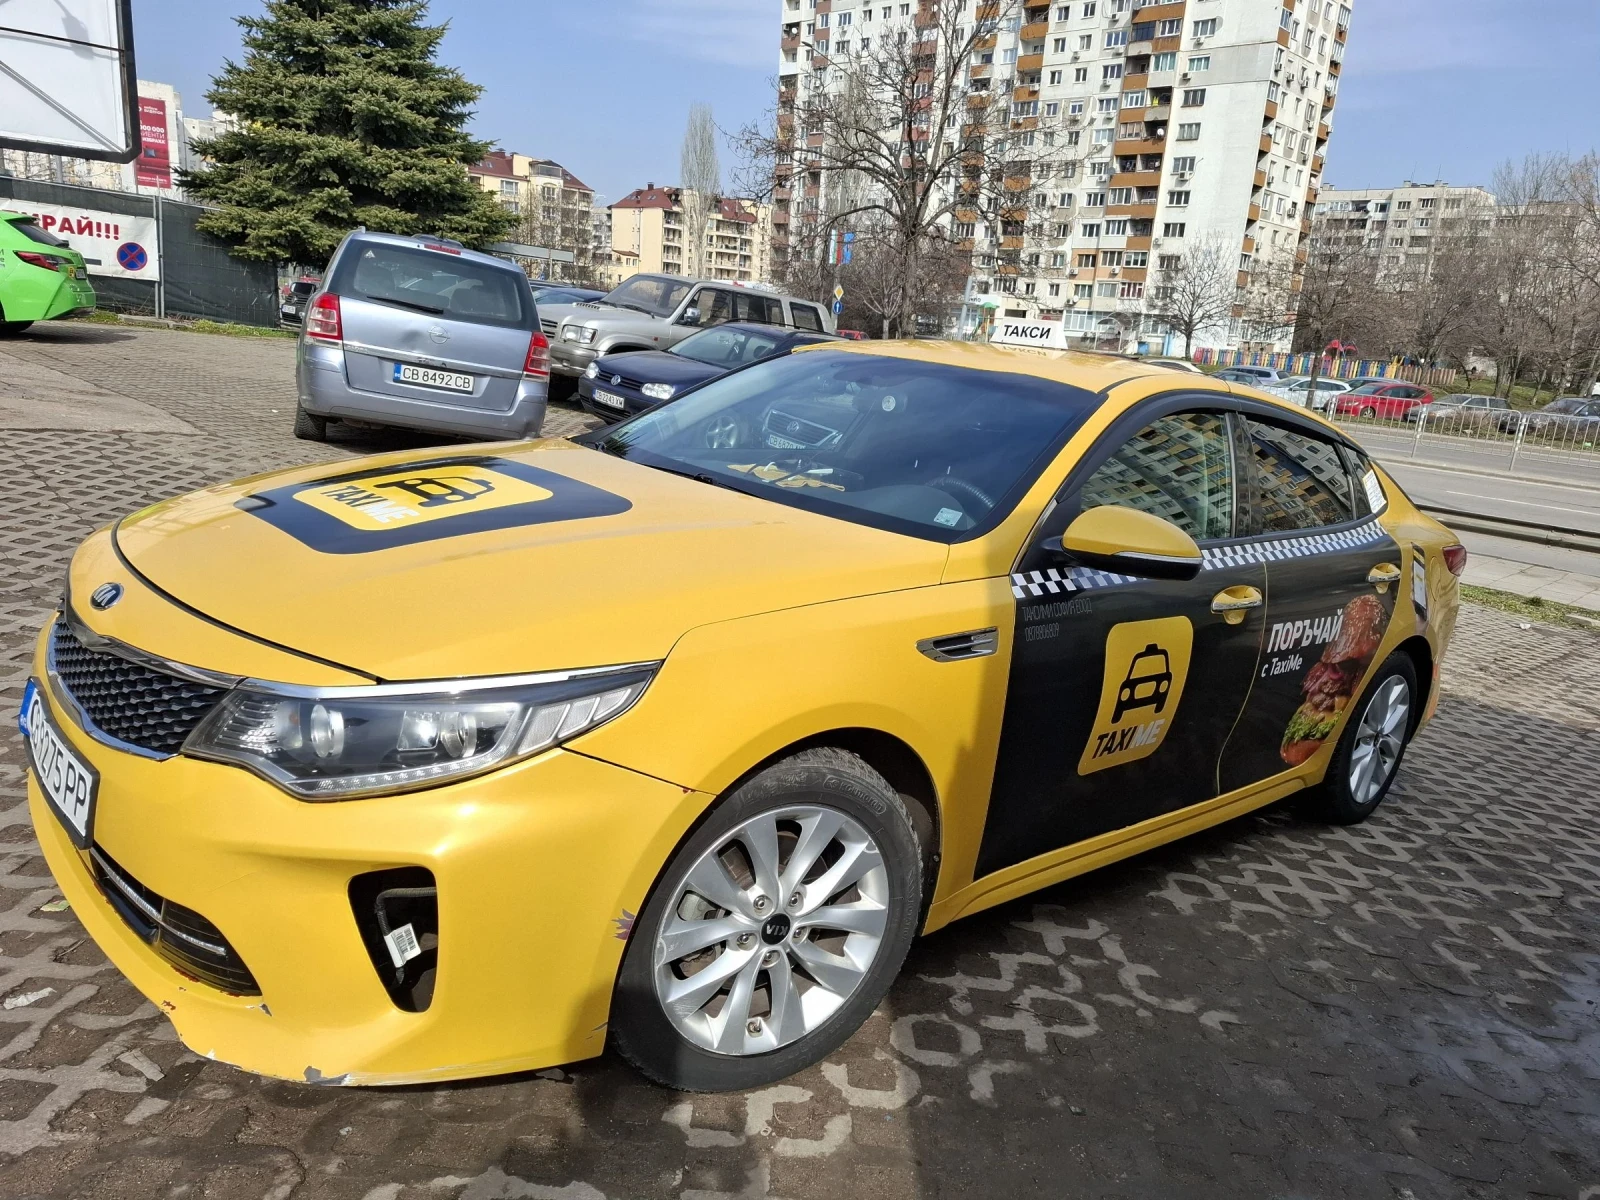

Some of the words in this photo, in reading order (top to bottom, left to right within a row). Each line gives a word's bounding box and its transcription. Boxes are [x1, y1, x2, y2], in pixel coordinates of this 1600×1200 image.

[1003, 324, 1051, 339] ТАКСИ
[402, 367, 419, 381] CB
[422, 371, 452, 386] 8492
[454, 376, 471, 389] CB
[93, 583, 117, 606] KIA
[1267, 608, 1344, 653] ПОРЪЧАЙ
[1270, 653, 1303, 676] TaxiMe
[63, 760, 87, 817] PP
[766, 924, 788, 936] KIA
